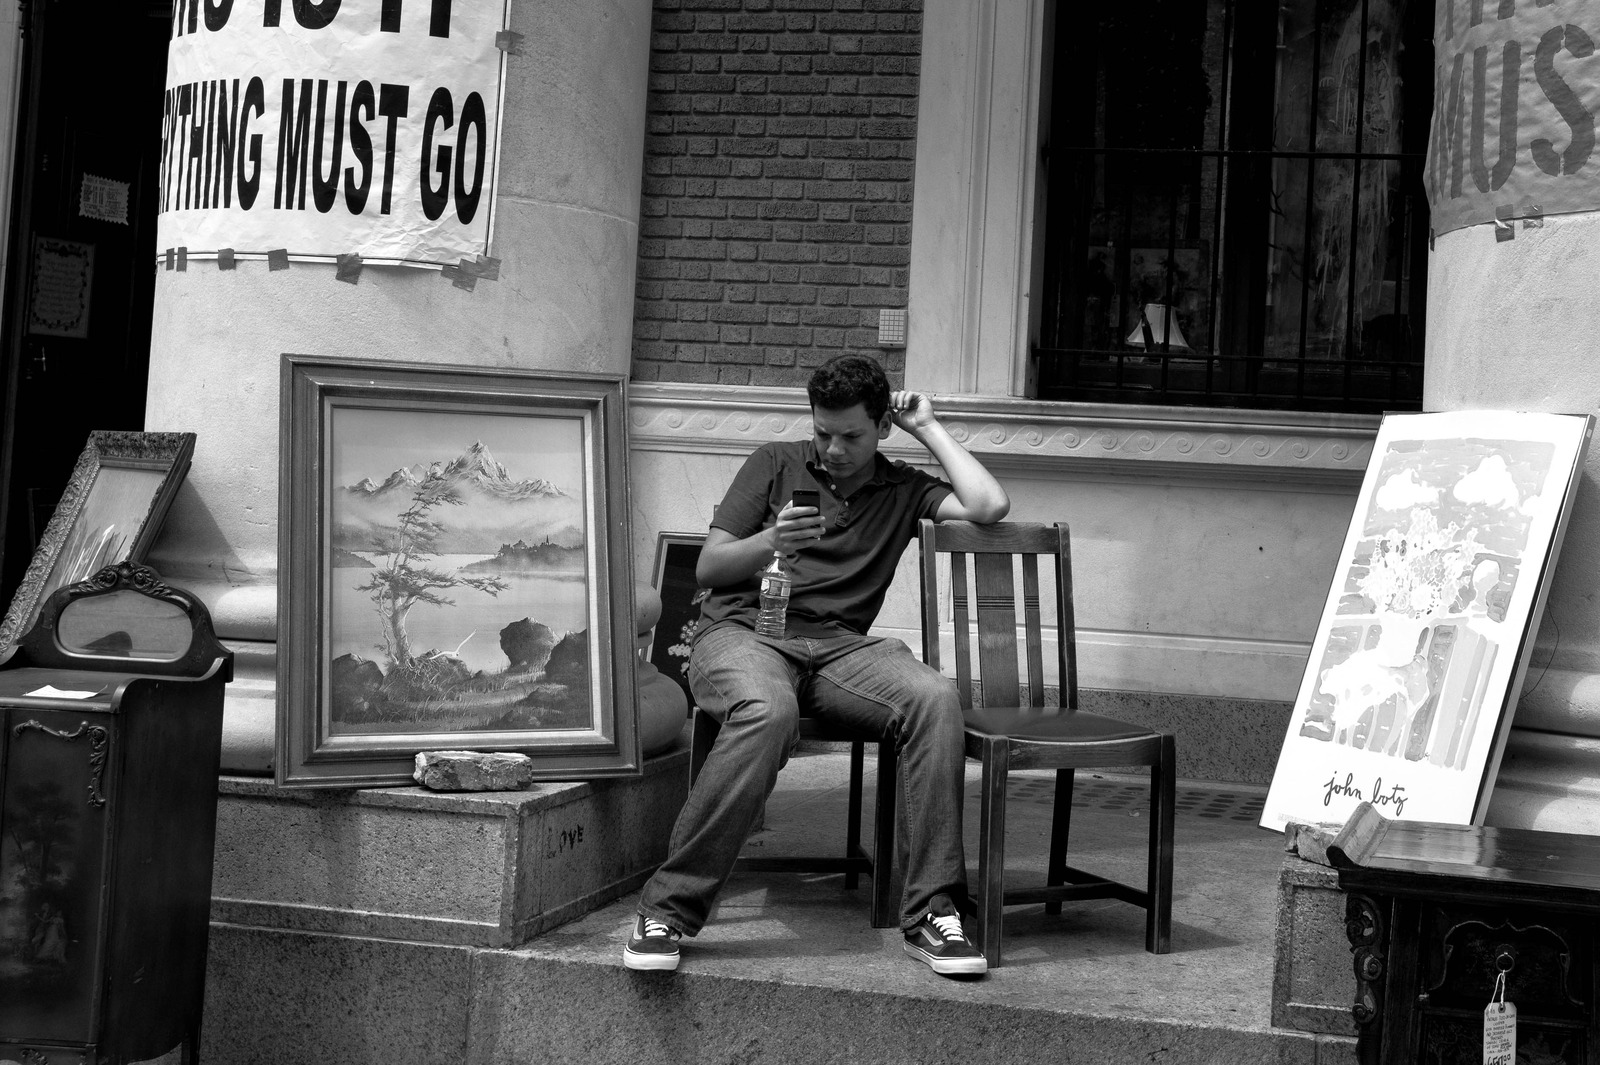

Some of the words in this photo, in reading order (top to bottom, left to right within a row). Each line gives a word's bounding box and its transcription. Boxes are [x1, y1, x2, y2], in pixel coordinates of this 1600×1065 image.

[273, 78, 410, 216] MUST
[420, 86, 487, 225] GO
[1323, 770, 1362, 807] john
